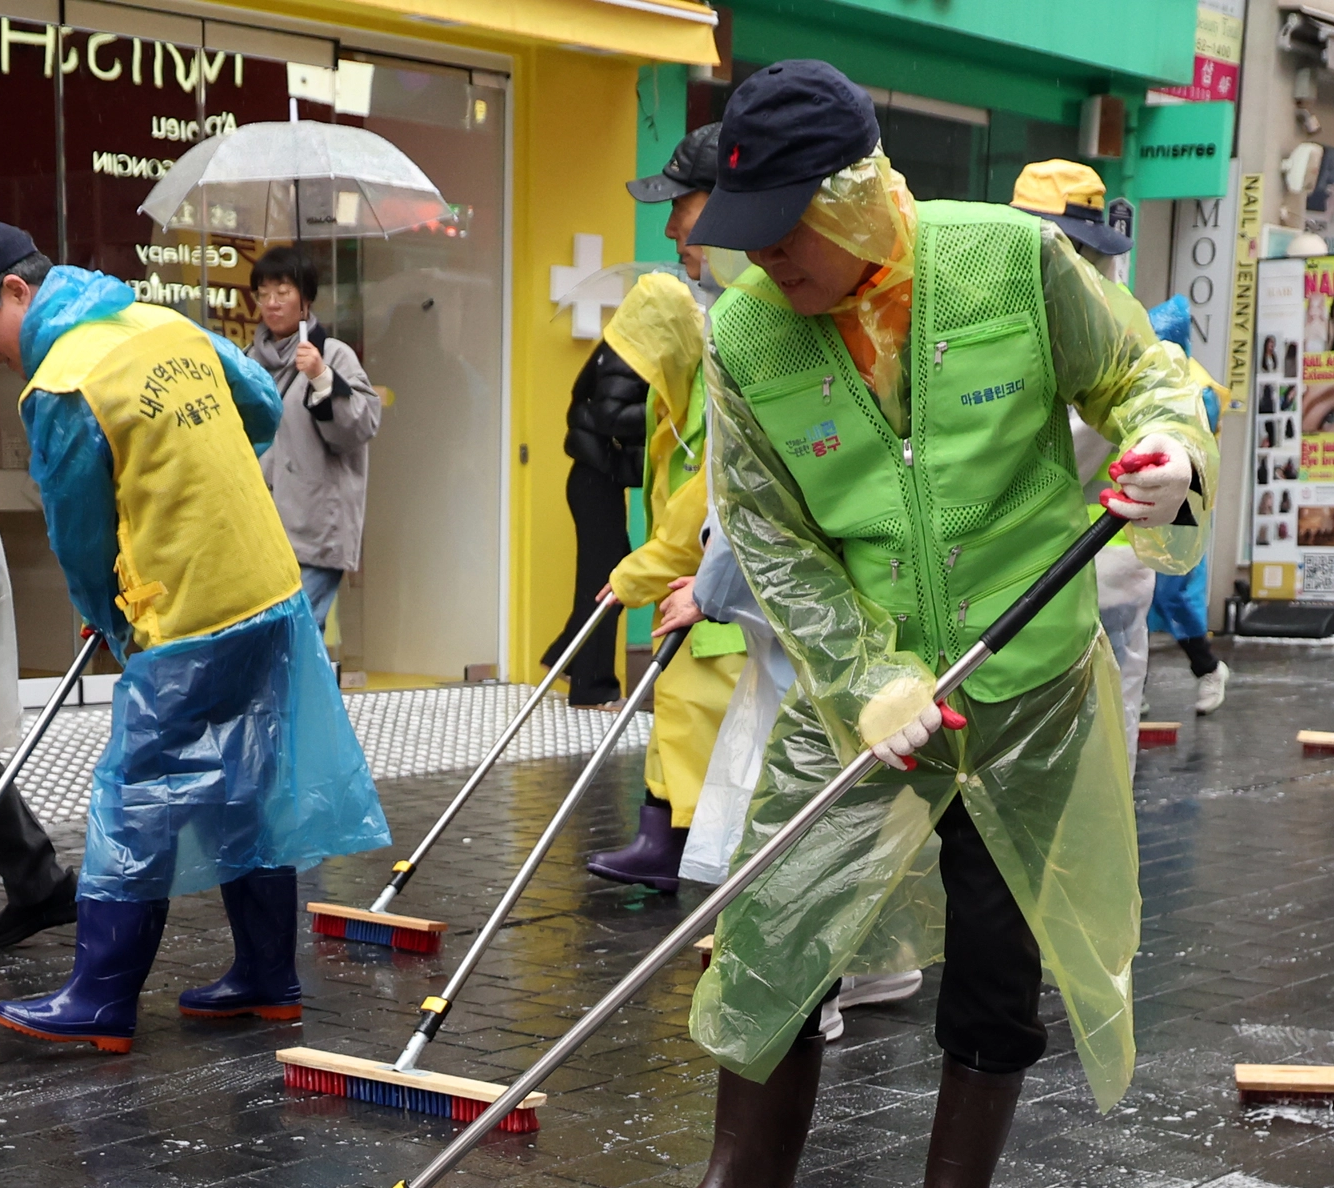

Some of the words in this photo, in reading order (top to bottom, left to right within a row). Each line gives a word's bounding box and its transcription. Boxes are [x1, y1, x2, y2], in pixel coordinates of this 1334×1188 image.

[1241, 175, 1260, 229] NAIL
[1235, 260, 1254, 332] JENNY
[1229, 339, 1249, 391] NAIL
